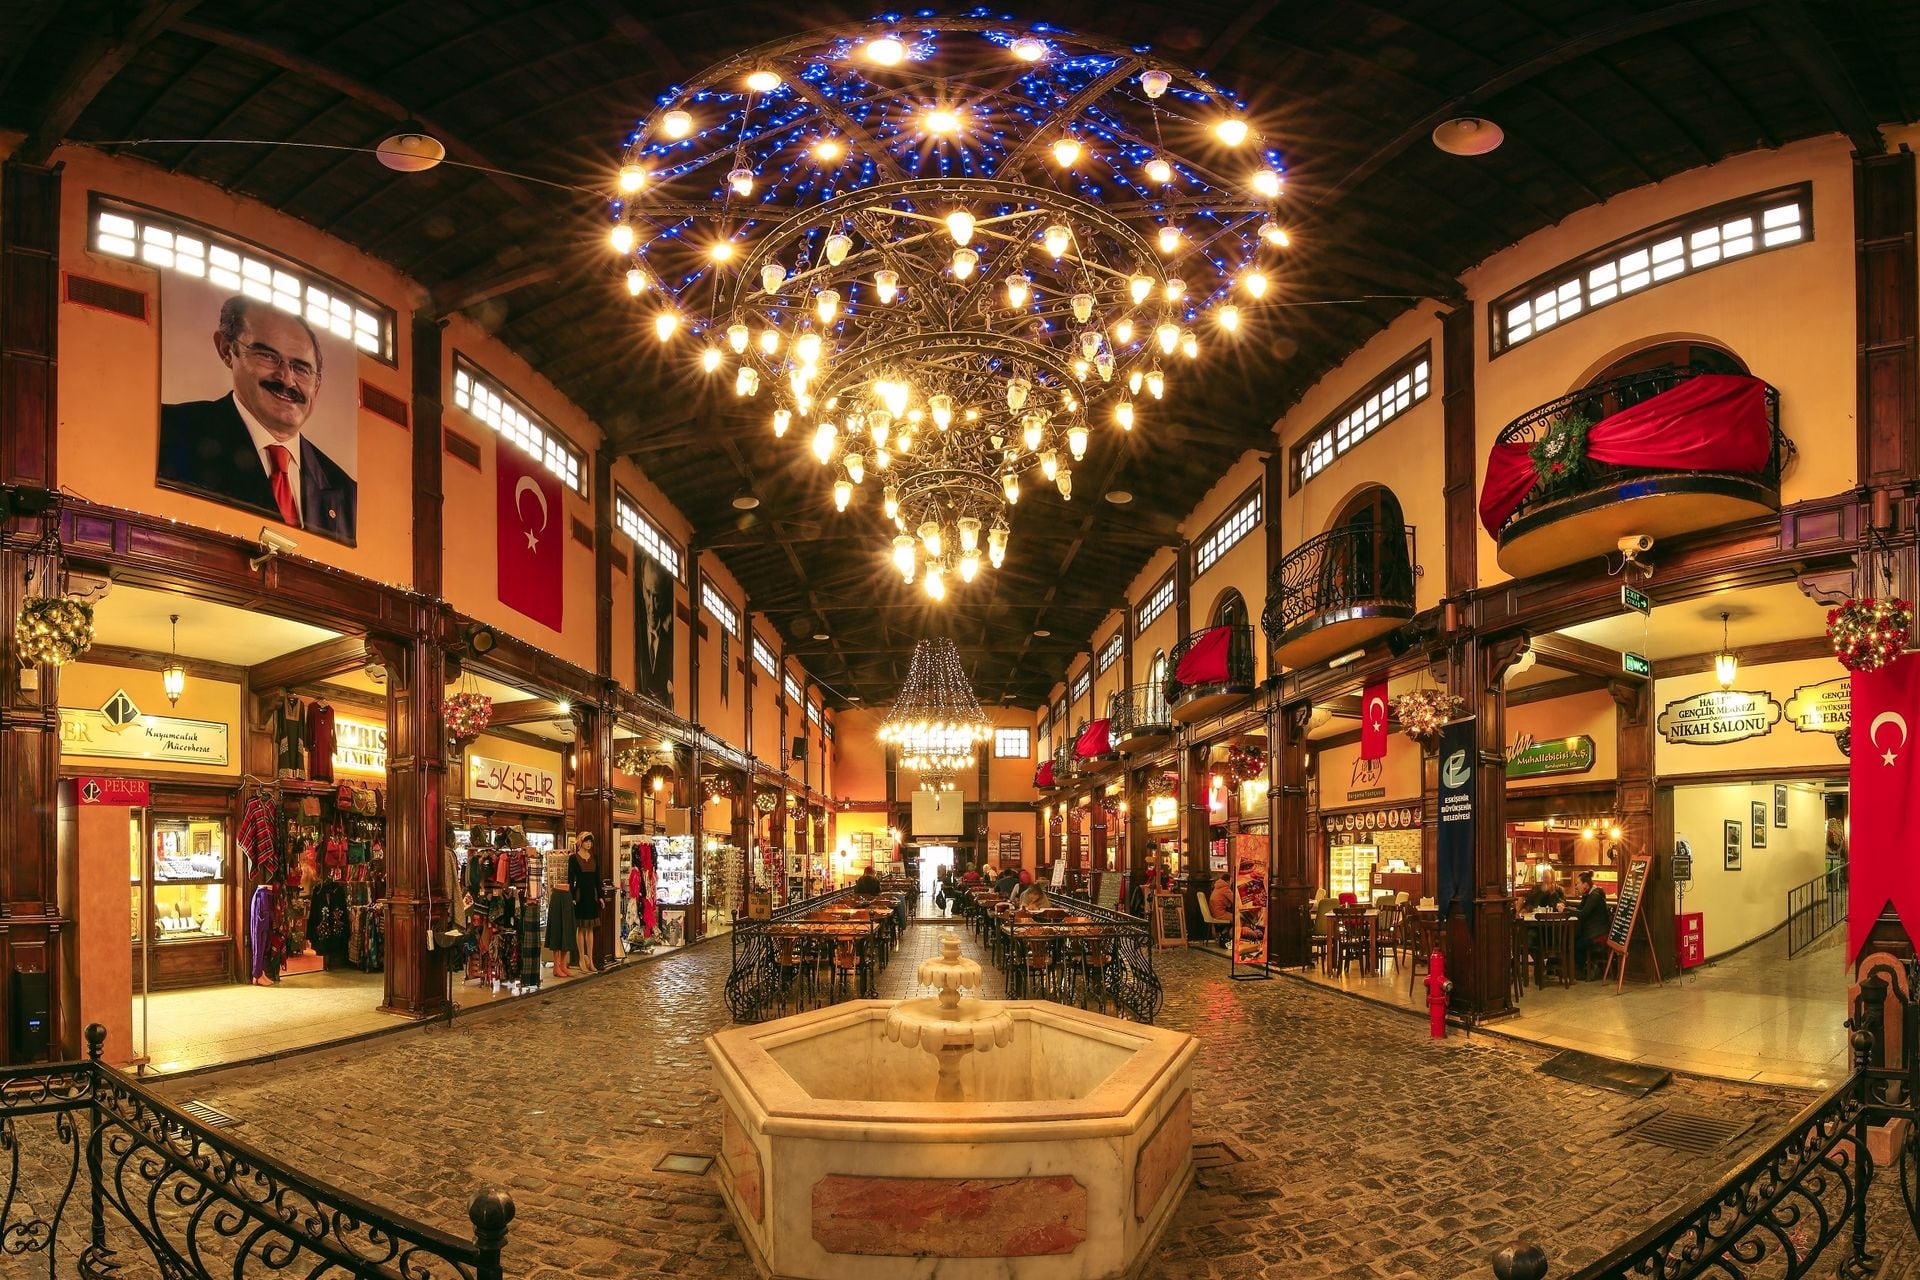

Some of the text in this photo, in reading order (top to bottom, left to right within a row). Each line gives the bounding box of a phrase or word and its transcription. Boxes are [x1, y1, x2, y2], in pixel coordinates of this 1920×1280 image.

[1626, 589, 1640, 600] EXIT
[1633, 661, 1644, 672] WC
[1678, 706, 1715, 719] GENÇLİK
[1670, 717, 1766, 737] NİKAH SALONU
[145, 727, 198, 742] Kuyumculuk
[1517, 752, 1569, 765] Muhallebicisi
[104, 779, 146, 796] PEKER
[476, 765, 555, 800] ESKİŞEHİR
[1444, 794, 1469, 804] ESKİŞEHİR
[1441, 803, 1472, 813] BÜYÜKŞEHİR
[1443, 812, 1471, 822] BELEDİYESİ
